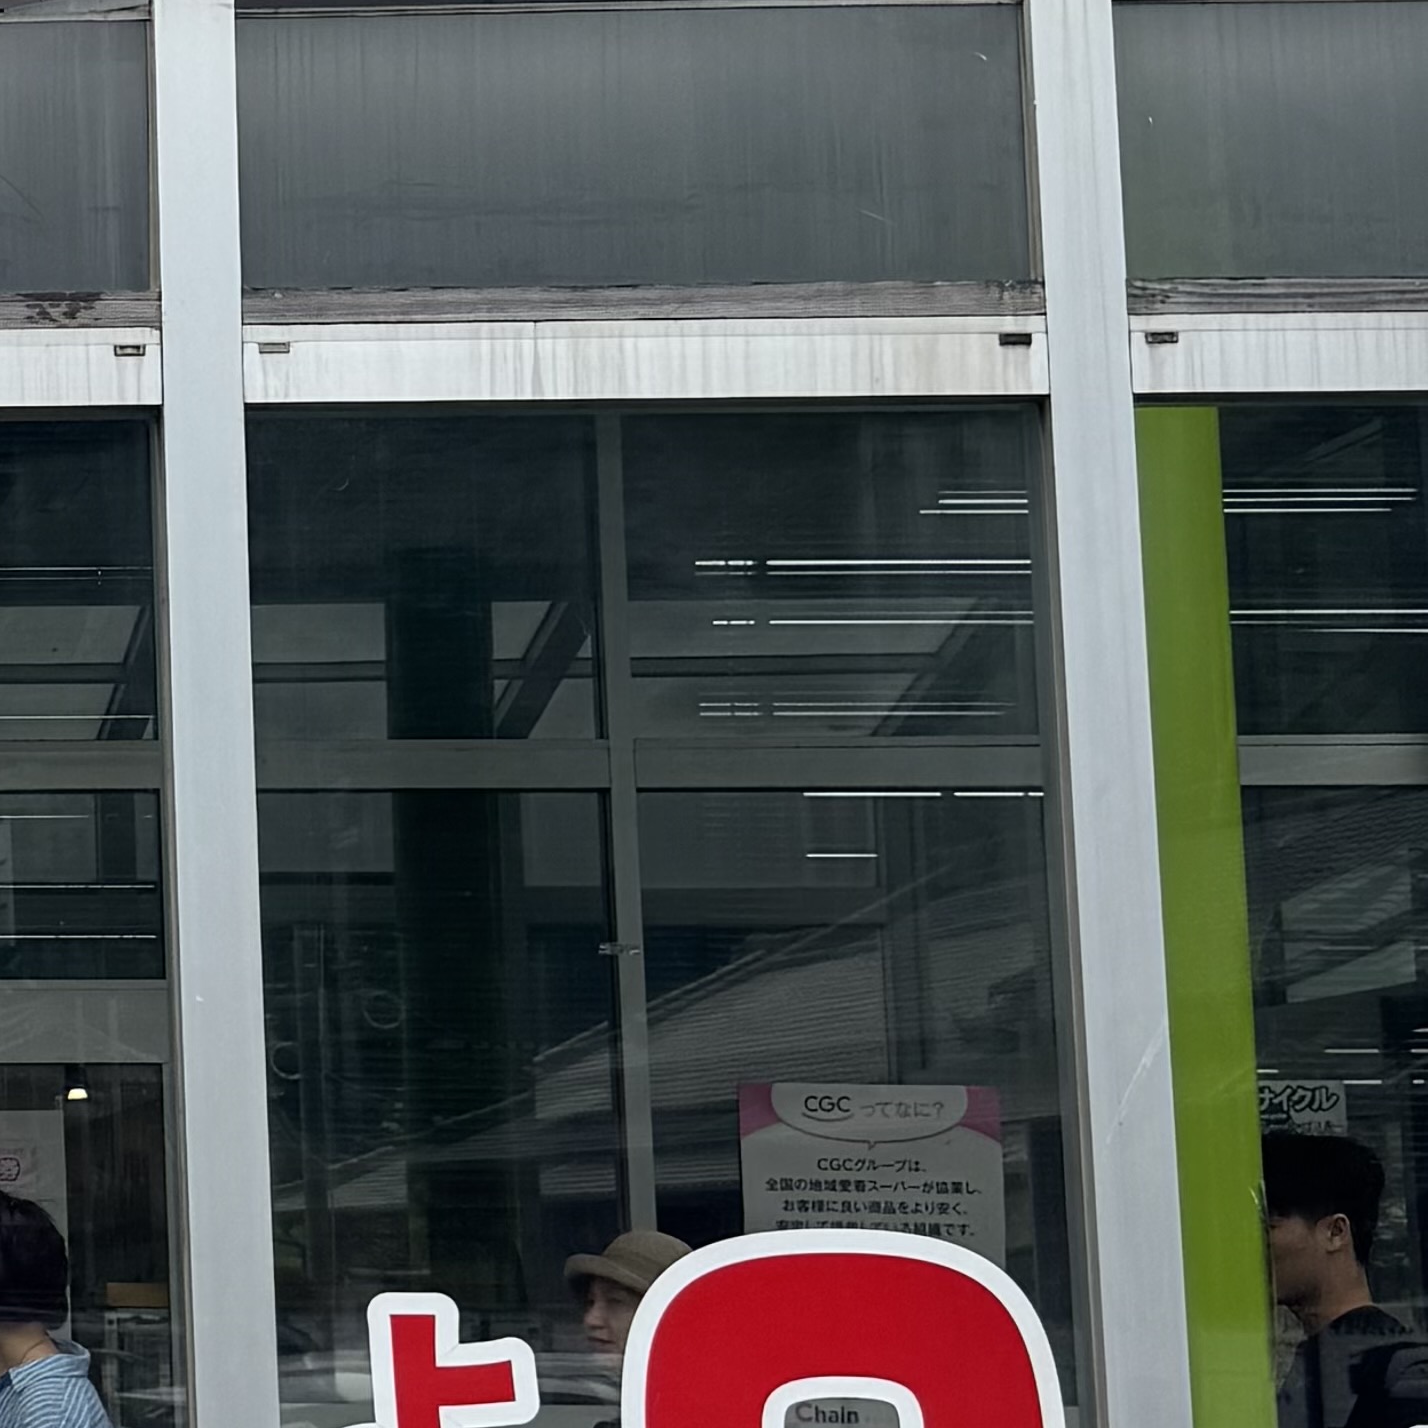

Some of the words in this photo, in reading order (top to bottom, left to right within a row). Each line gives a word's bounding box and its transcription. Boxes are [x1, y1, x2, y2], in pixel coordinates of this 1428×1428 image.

[803, 1095, 852, 1113] CGC
[860, 1101, 944, 1119] ってなに?
